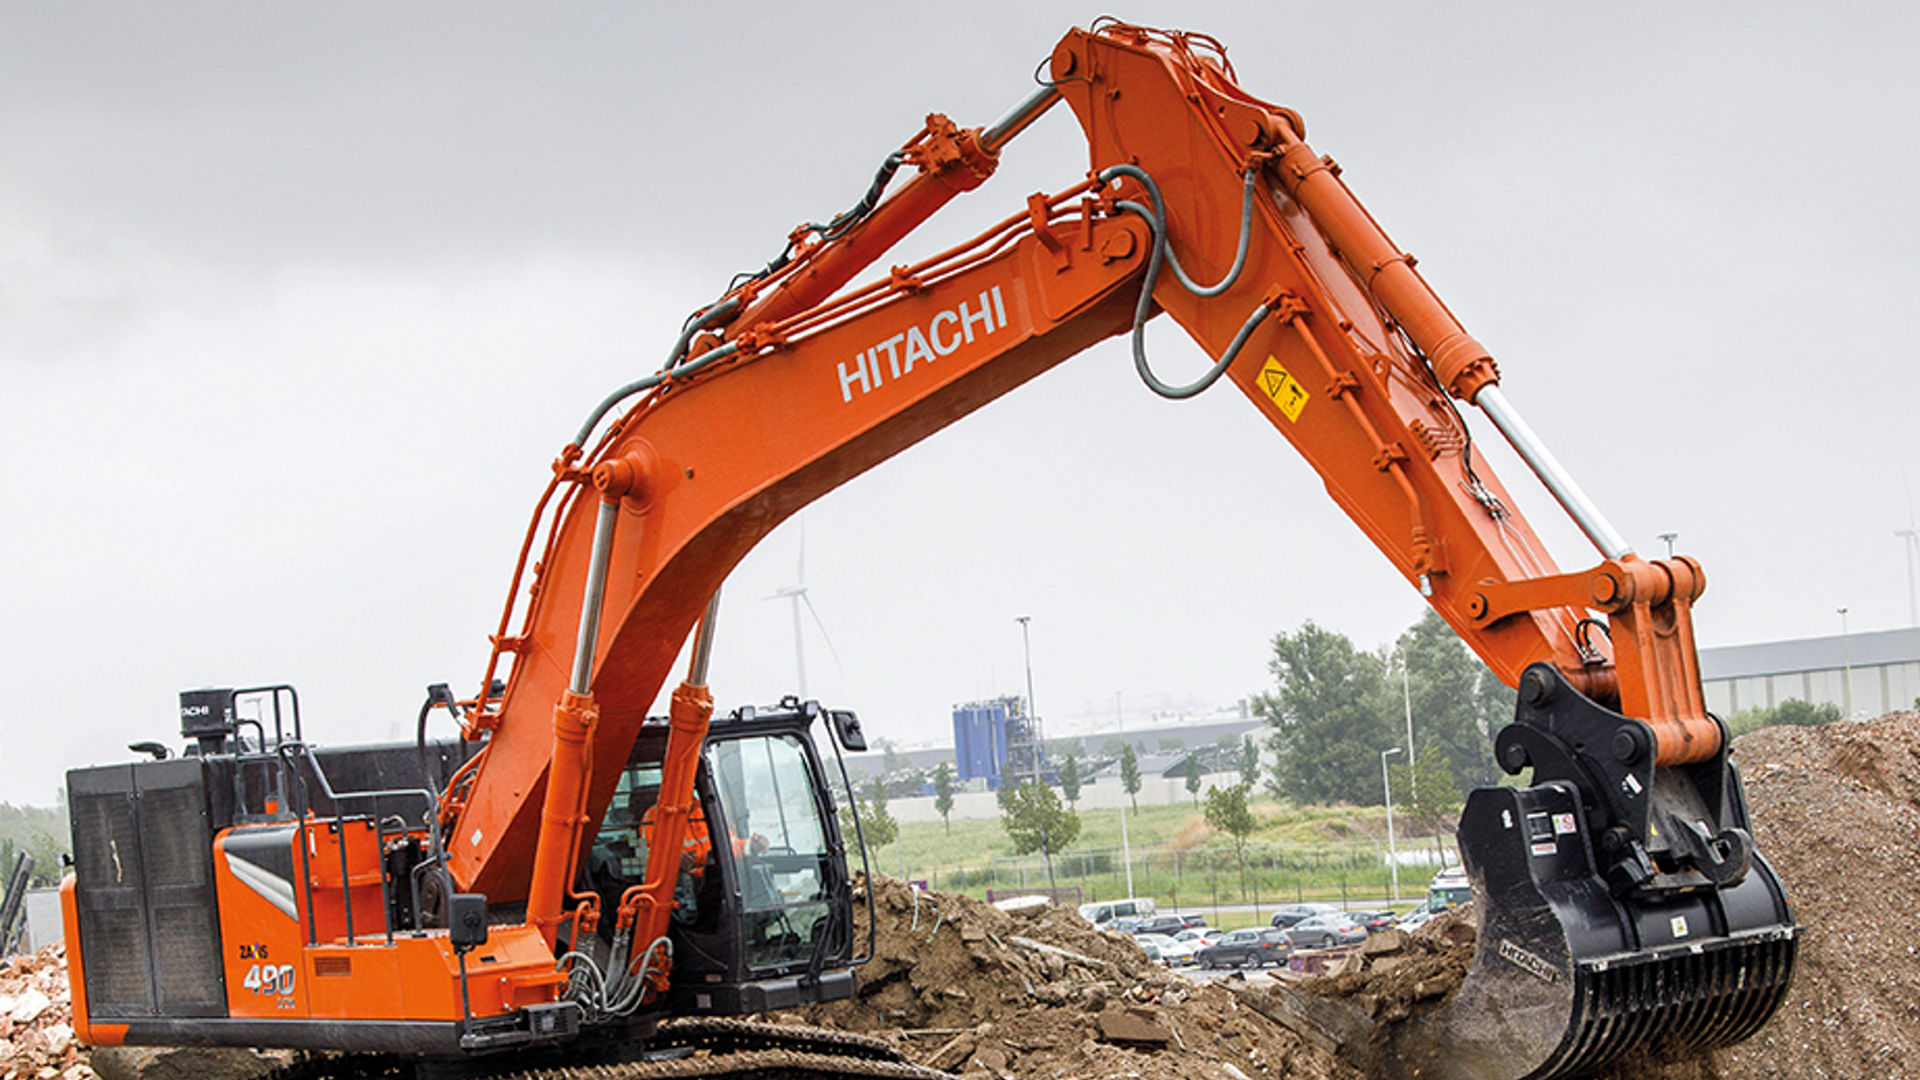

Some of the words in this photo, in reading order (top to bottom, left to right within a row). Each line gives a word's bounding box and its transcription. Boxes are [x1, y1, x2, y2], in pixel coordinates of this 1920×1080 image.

[837, 285, 1008, 403] HITACHI
[1501, 942, 1553, 979] HITACHI
[244, 965, 295, 995] 490
